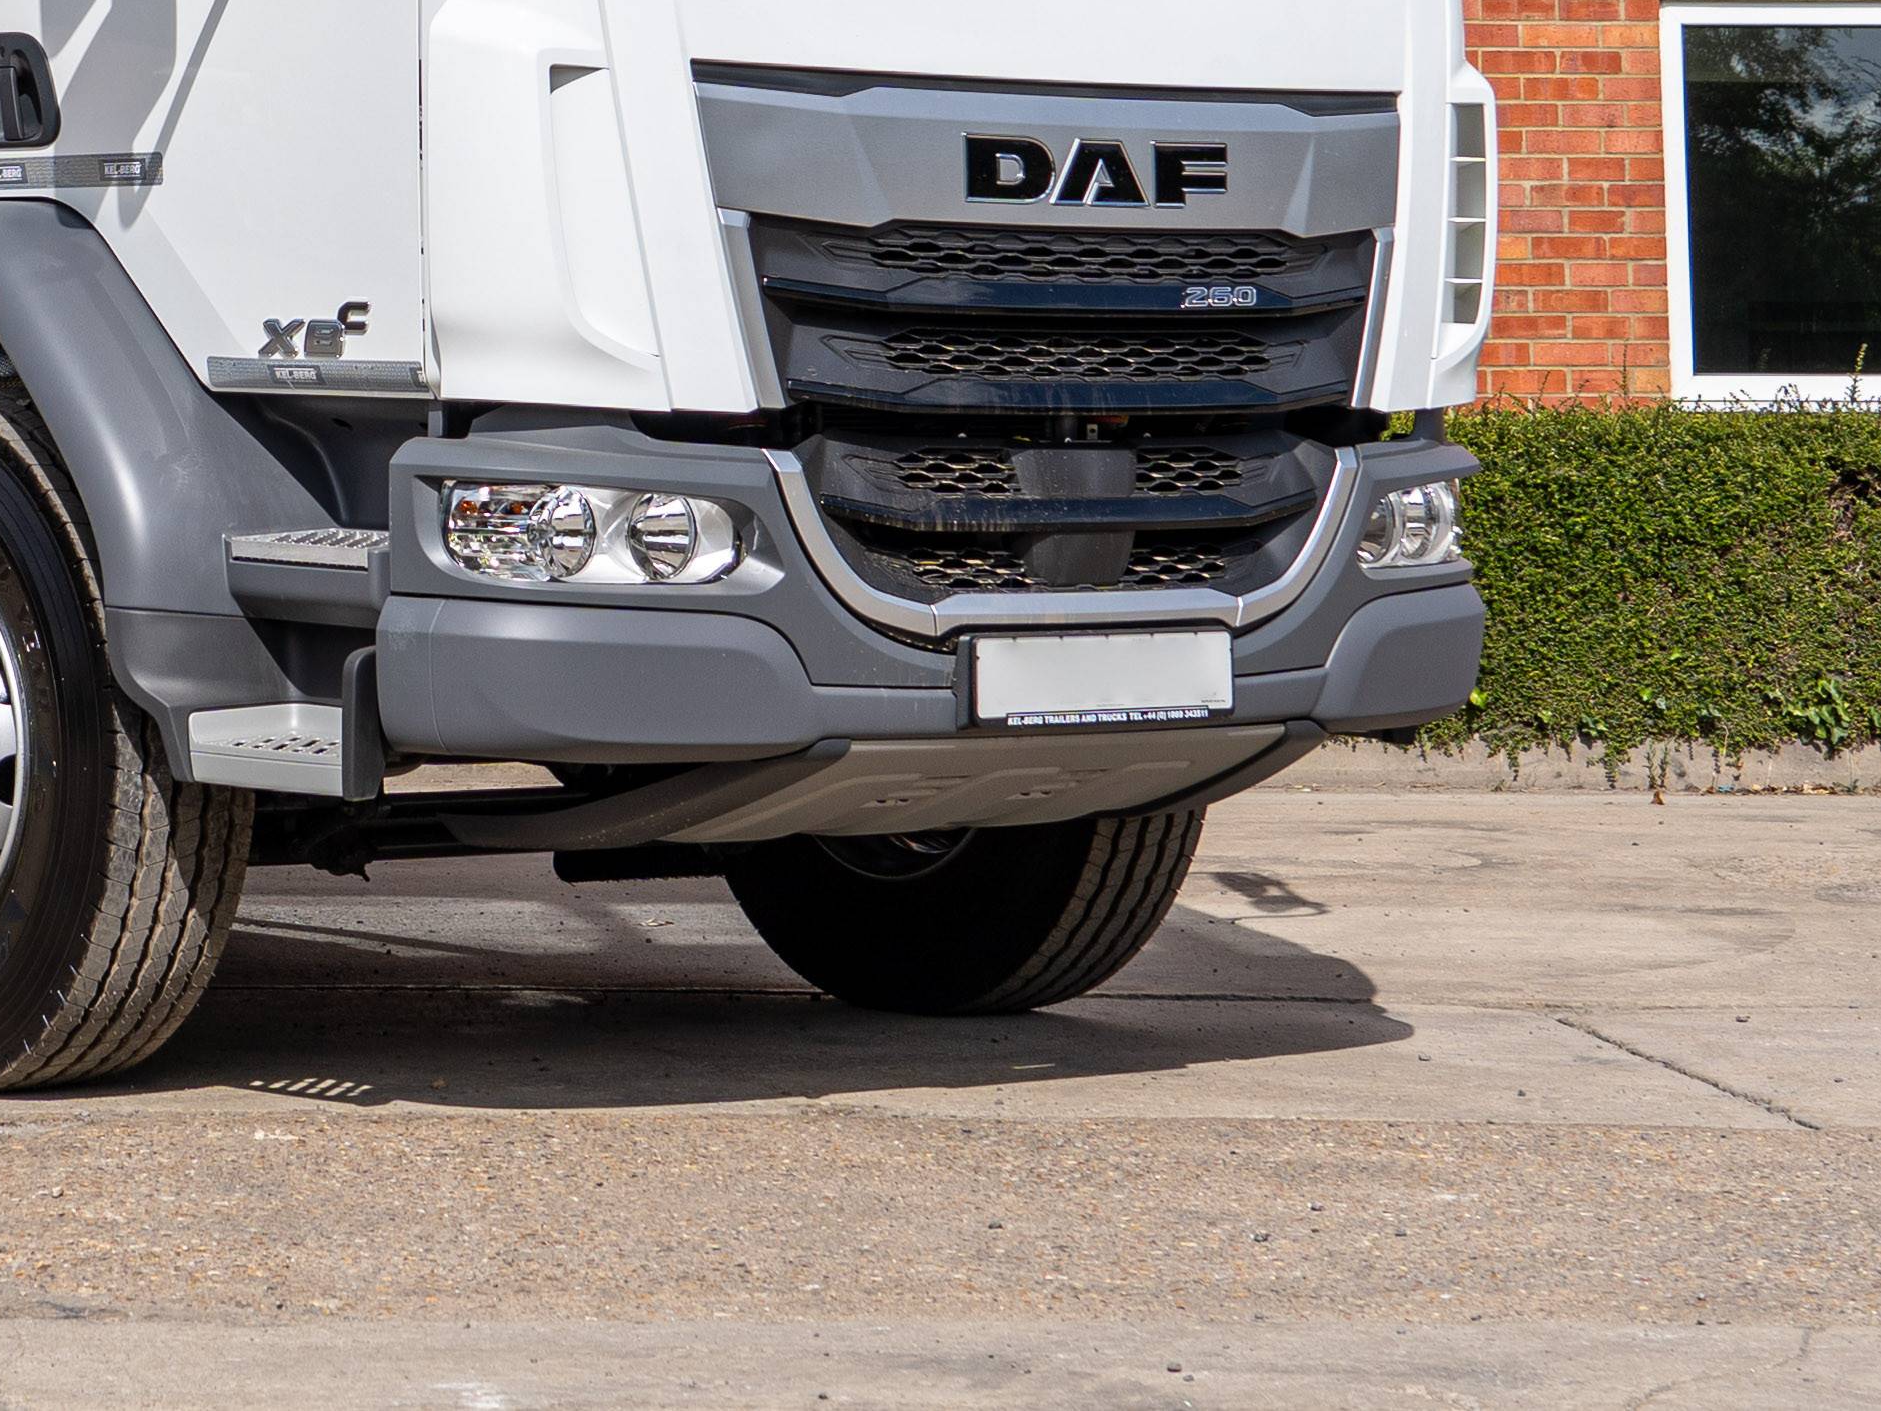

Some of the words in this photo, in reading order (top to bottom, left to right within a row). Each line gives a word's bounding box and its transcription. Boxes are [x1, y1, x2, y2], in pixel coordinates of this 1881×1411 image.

[961, 132, 1229, 209] DAF
[1184, 286, 1257, 307] 260
[1007, 715, 1044, 726] KEL-BERG
[1044, 714, 1080, 725] TRAILERS
[1081, 713, 1097, 723] AND
[1098, 712, 1127, 722] TRUCKS
